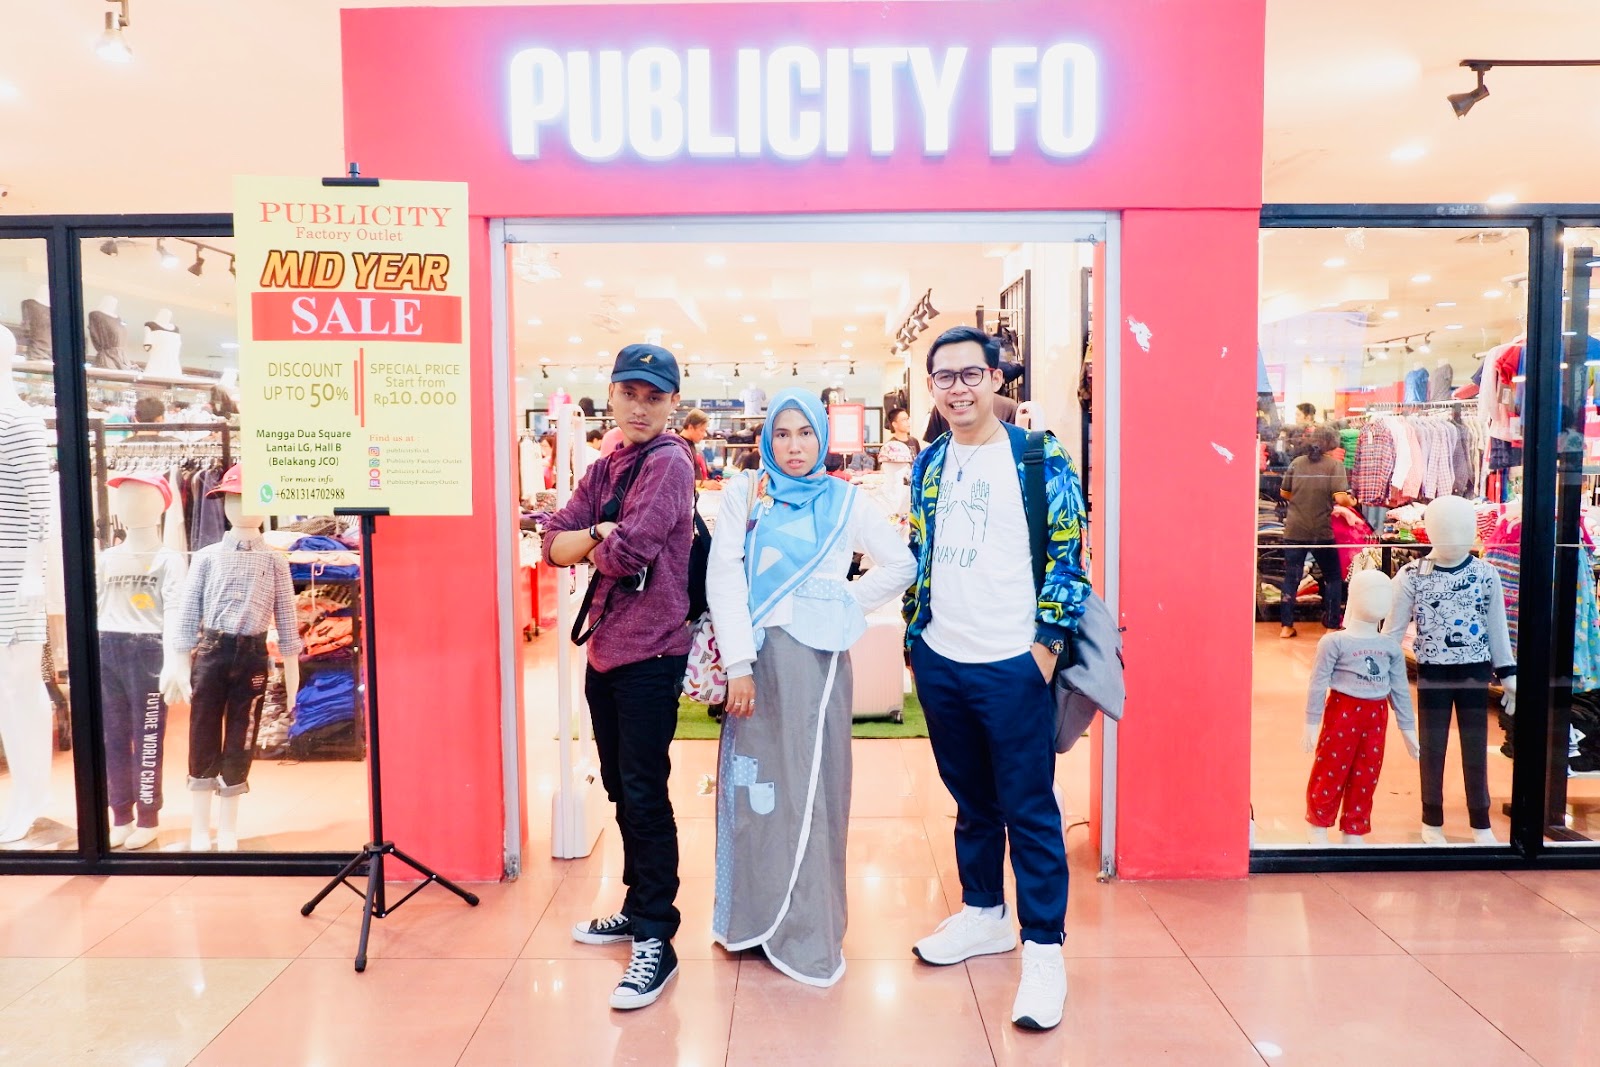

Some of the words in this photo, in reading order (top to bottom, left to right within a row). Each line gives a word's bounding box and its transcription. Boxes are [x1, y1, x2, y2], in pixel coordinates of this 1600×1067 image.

[508, 45, 968, 161] PUBLICITY
[989, 42, 1098, 159] FO
[259, 201, 452, 228] PUBLICITY
[295, 226, 350, 242] Factory
[356, 228, 403, 242] Outlet
[259, 250, 346, 289] MID
[352, 251, 450, 291] YEAR
[291, 296, 424, 336] SALE
[268, 362, 343, 378] DISCOUNT
[370, 363, 422, 375] SPECIAL
[425, 364, 460, 375] PRICE
[385, 376, 415, 388] Start
[418, 376, 446, 388] from
[310, 382, 349, 408] 50%
[373, 391, 457, 408] Rp10.000
[256, 429, 295, 441] Mangga
[297, 429, 316, 438] Dua
[318, 429, 352, 440] Square
[369, 434, 390, 442] Find
[266, 443, 296, 452] Lantai
[298, 443, 313, 453] LG,
[314, 443, 334, 452] Hall
[335, 443, 342, 452] B
[268, 457, 316, 468] (Belakang
[318, 457, 339, 467] JCO)
[280, 475, 293, 483] For
[318, 475, 334, 485] info
[275, 488, 345, 500] +6281314702988
[959, 548, 978, 569] UP
[1422, 592, 1456, 600] POW
[1352, 649, 1387, 657] BEDTIM
[144, 692, 160, 730] FUTURE
[142, 733, 158, 767] WORLD
[139, 770, 155, 805] CHAMP
